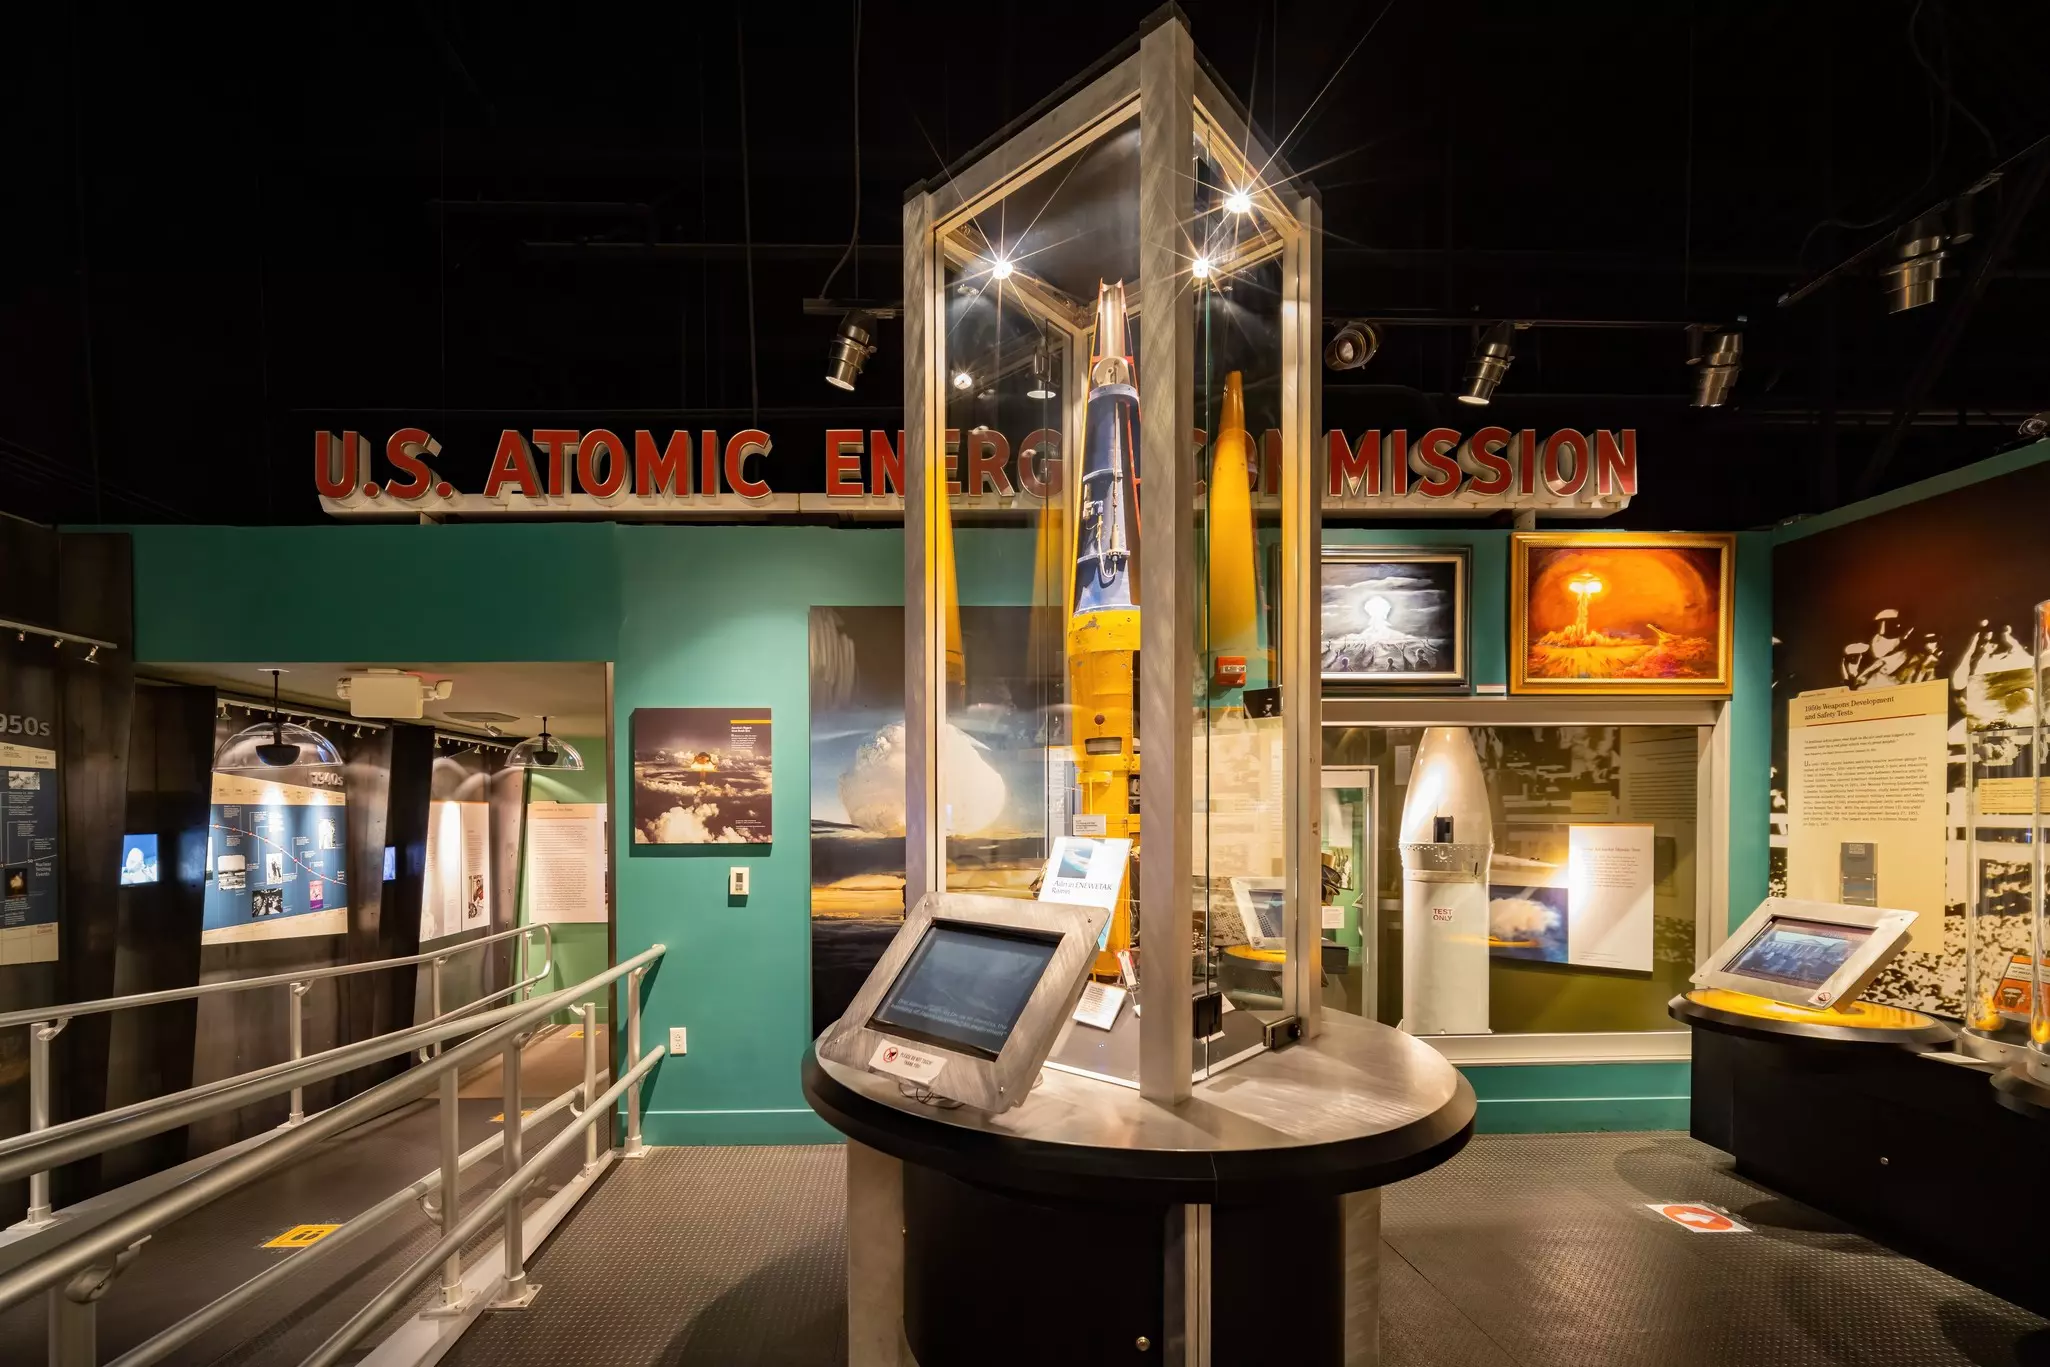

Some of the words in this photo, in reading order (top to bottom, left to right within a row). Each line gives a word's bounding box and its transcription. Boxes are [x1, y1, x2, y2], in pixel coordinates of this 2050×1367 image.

[315, 428, 454, 499] U.S.
[483, 429, 772, 499] ATOMIC
[825, 428, 1063, 499] ENRG
[1822, 702, 1850, 711] Weapons
[1850, 696, 1894, 707] Development
[1816, 712, 1836, 720] Safety
